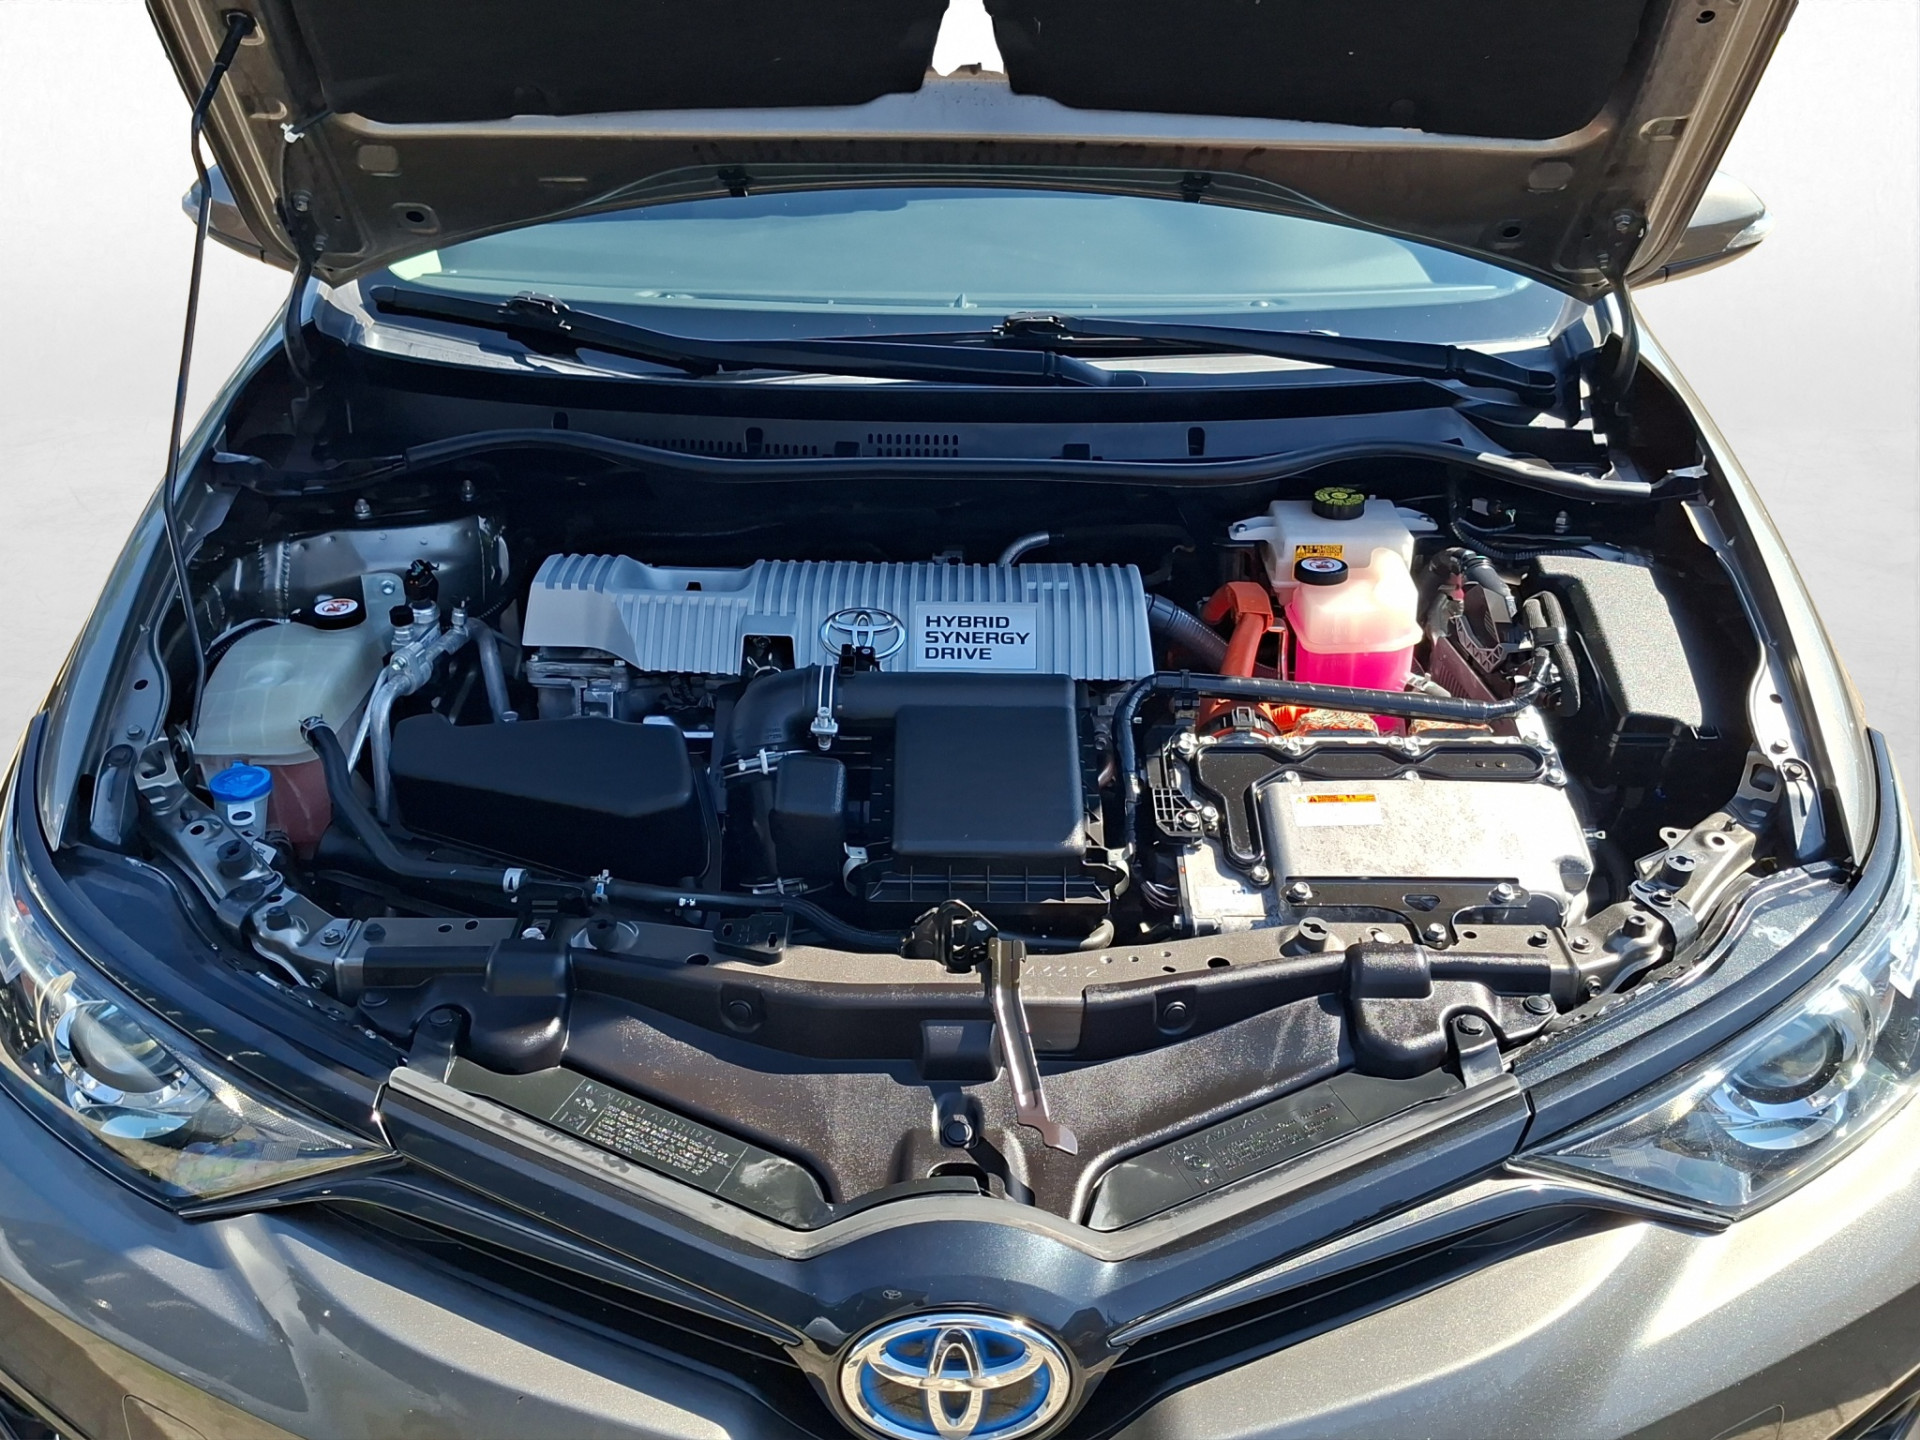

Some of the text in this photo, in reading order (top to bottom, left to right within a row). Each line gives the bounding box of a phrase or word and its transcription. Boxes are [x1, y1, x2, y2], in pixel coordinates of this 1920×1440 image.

[925, 615, 1010, 629] HYBRID
[924, 630, 1031, 645] SYNERGY
[924, 646, 993, 661] DRIVE
